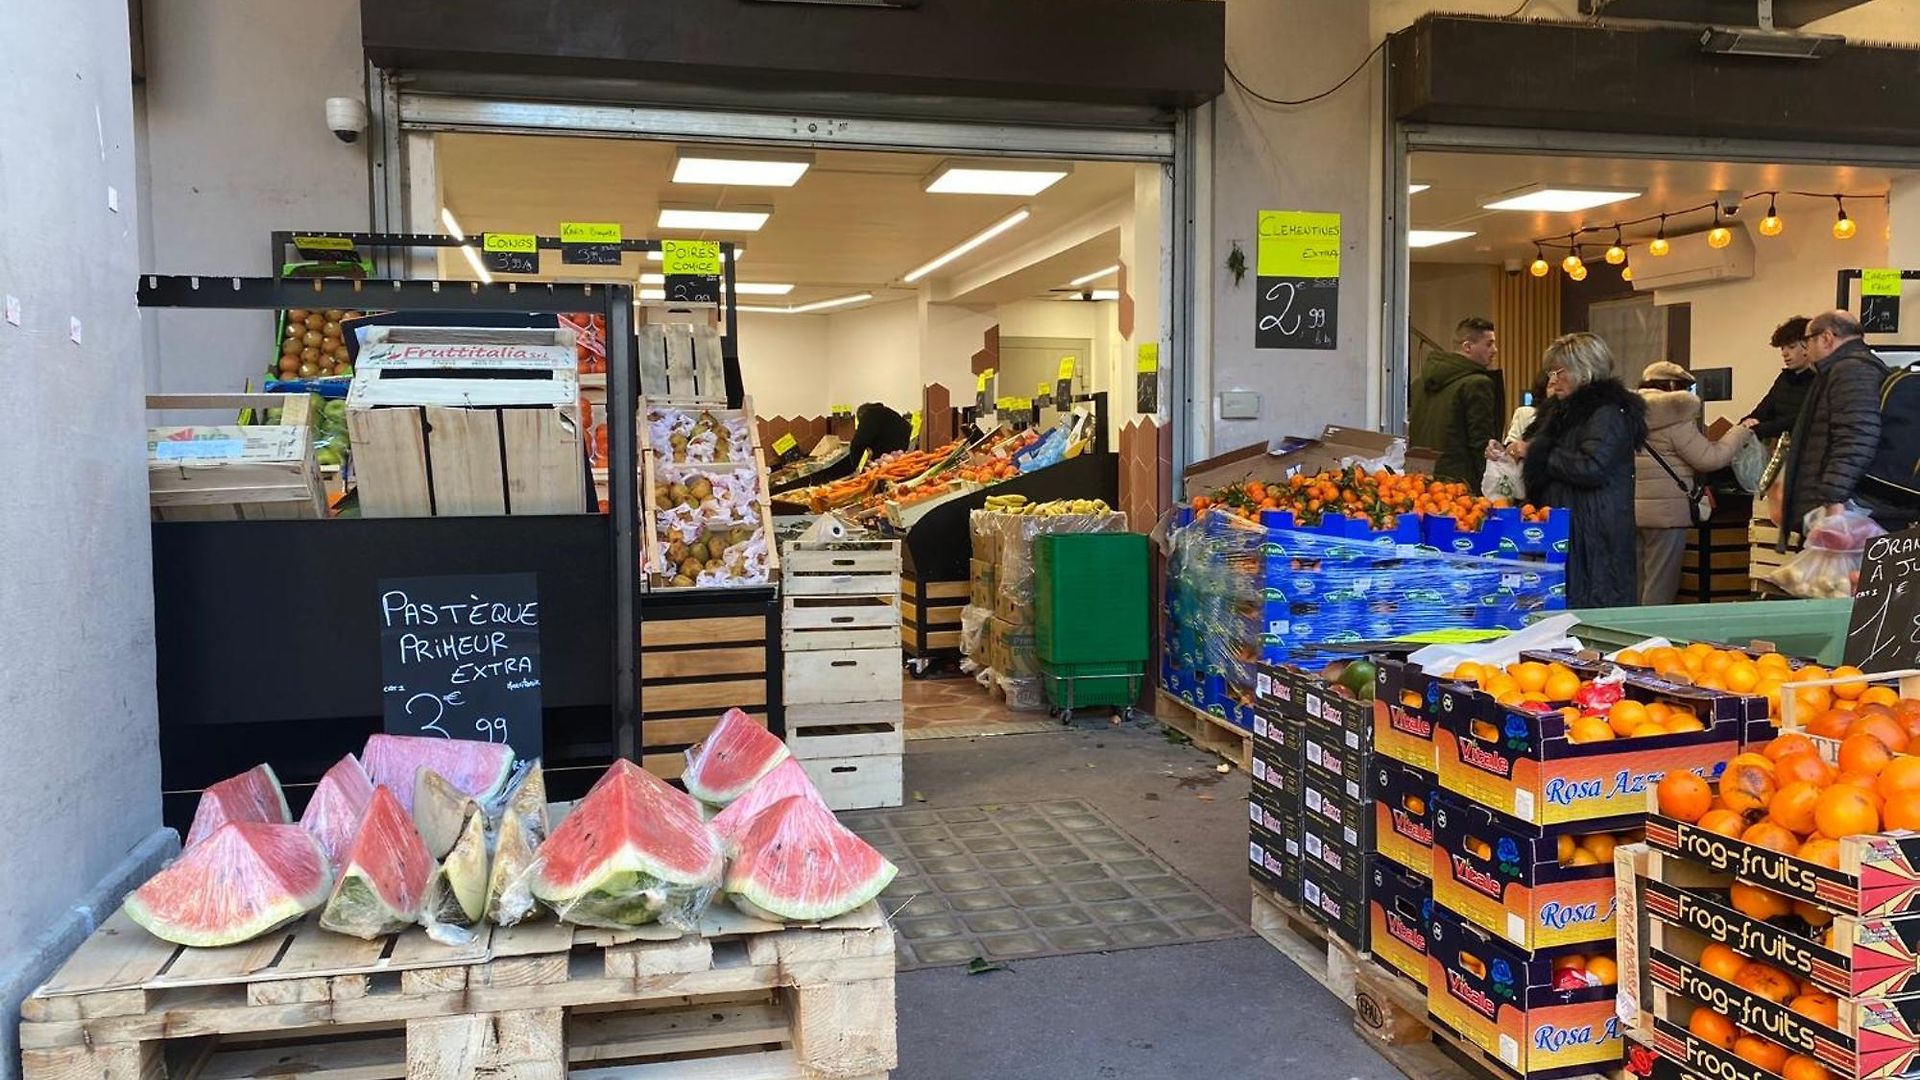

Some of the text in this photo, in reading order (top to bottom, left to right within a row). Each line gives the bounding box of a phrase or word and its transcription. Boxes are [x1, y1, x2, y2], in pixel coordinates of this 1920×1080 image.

[1260, 216, 1340, 236] CLEMENTINES
[666, 242, 716, 259] POIRES
[672, 261, 713, 272] COMICE
[404, 345, 526, 360] Fruttitalia
[382, 590, 539, 627] PASTÈQUE
[400, 632, 508, 665] PRIMEUR
[451, 656, 532, 684] EXTRA
[1390, 704, 1431, 735] Vitale
[1459, 736, 1509, 773] Vitale
[1546, 776, 1602, 806] Rosa
[1392, 808, 1433, 844] Vitale
[1452, 853, 1500, 895] Vitale
[1677, 824, 1816, 893] Frog-fruits
[1387, 910, 1426, 950] Vitale
[1540, 901, 1596, 930] Rosa
[1678, 894, 1812, 974] Frog-fruits
[1447, 967, 1495, 1015] Vitale
[1680, 965, 1816, 1050] Frog-fruits
[1534, 1023, 1591, 1052] Rosa
